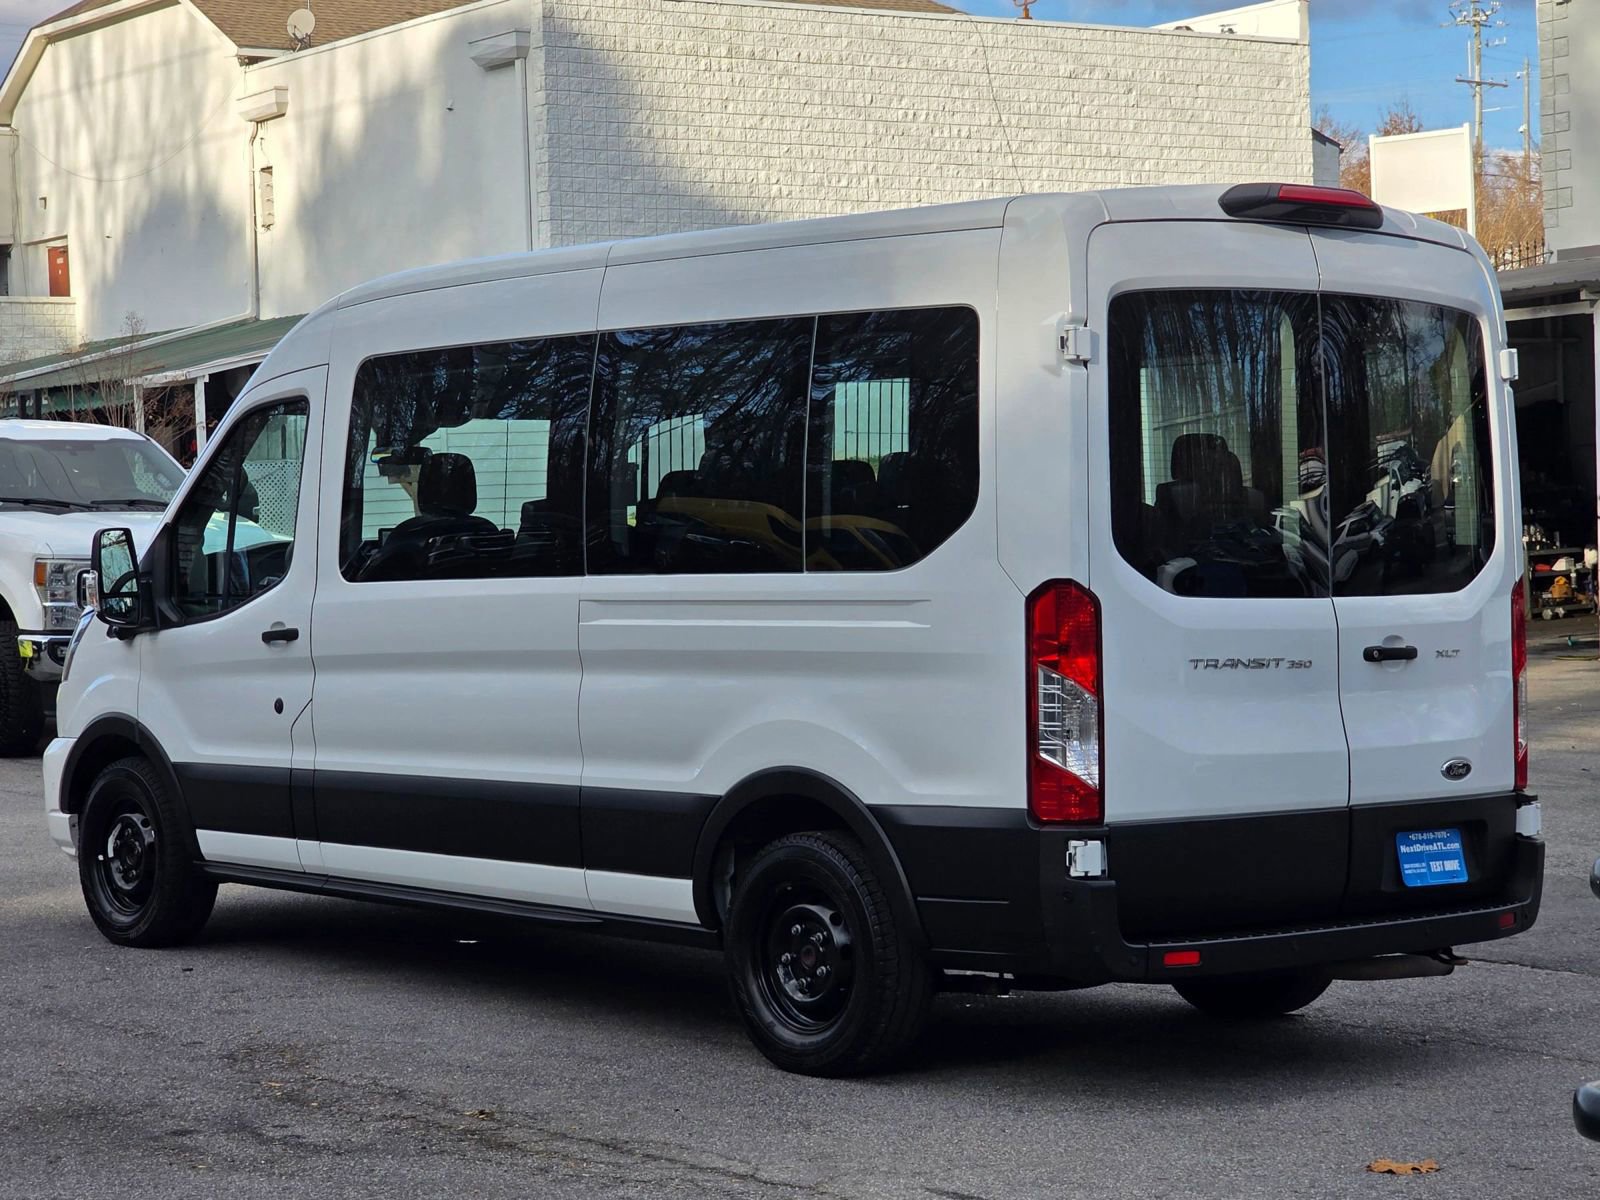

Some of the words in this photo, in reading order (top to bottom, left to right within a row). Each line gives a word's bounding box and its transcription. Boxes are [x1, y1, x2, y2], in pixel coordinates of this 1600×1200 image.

[1435, 649, 1460, 659] XLT
[1188, 658, 1285, 670] TRANSIT
[1286, 660, 1312, 670] 350
[1400, 842, 1461, 854] NextDriveATL.com
[1429, 861, 1444, 873] TEST
